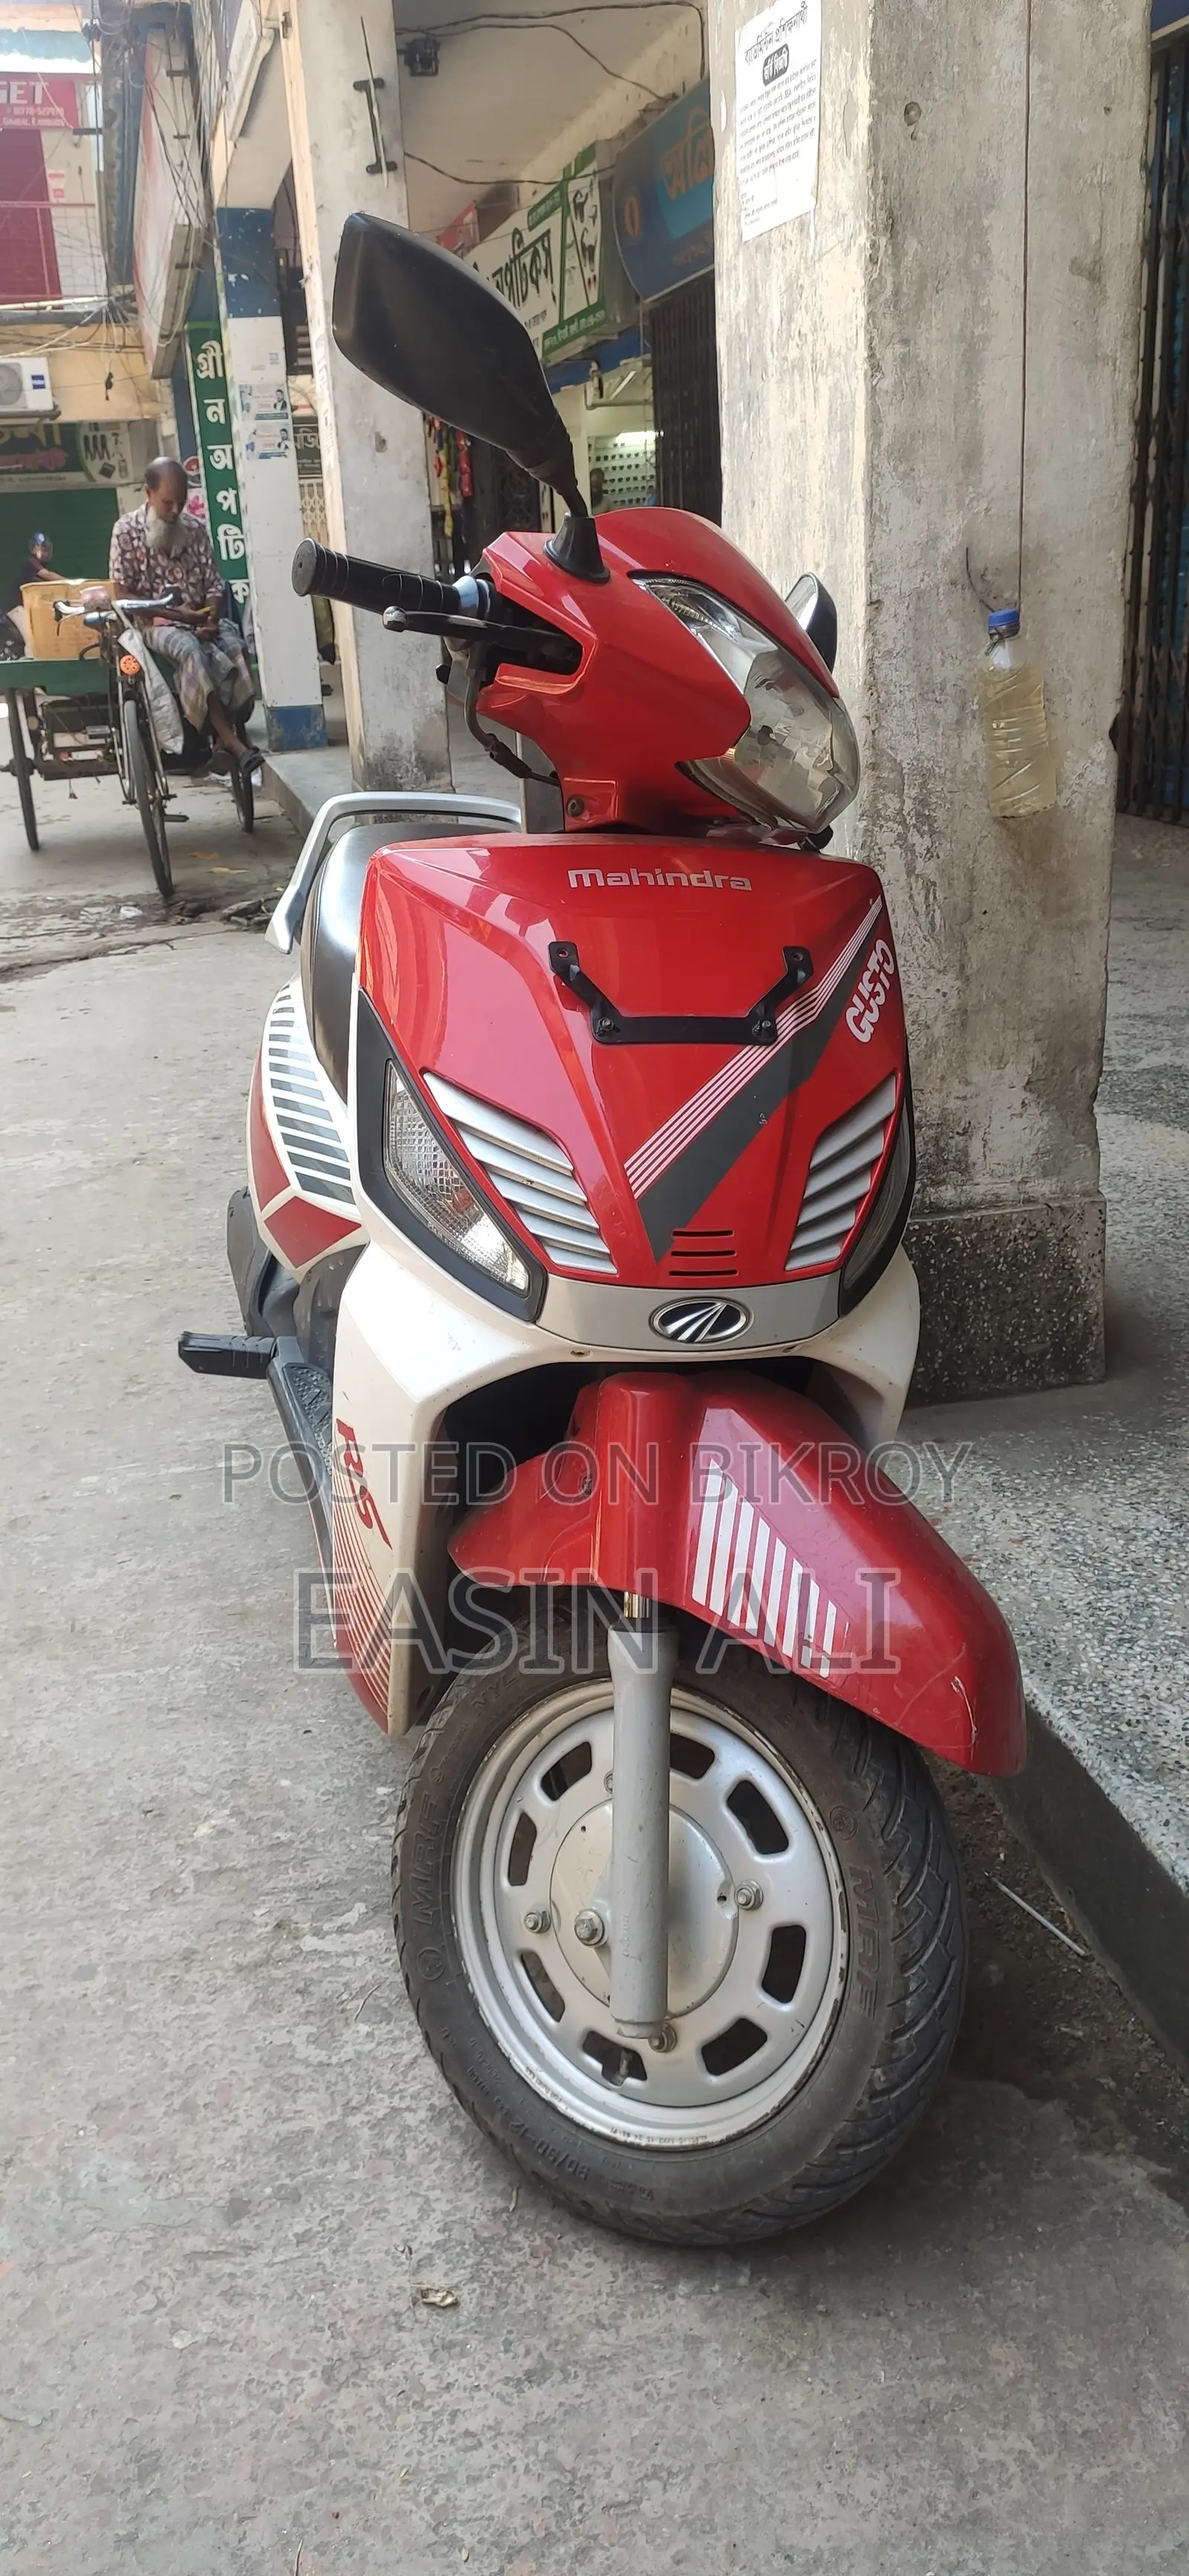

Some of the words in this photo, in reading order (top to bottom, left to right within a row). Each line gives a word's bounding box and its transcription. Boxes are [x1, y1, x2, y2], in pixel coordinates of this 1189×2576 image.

[567, 868, 752, 892] Mahindra
[846, 938, 895, 1043] GUSTO
[336, 1418, 393, 1551] RS
[411, 1794, 440, 1926] MRF
[849, 1863, 880, 2021] MRF
